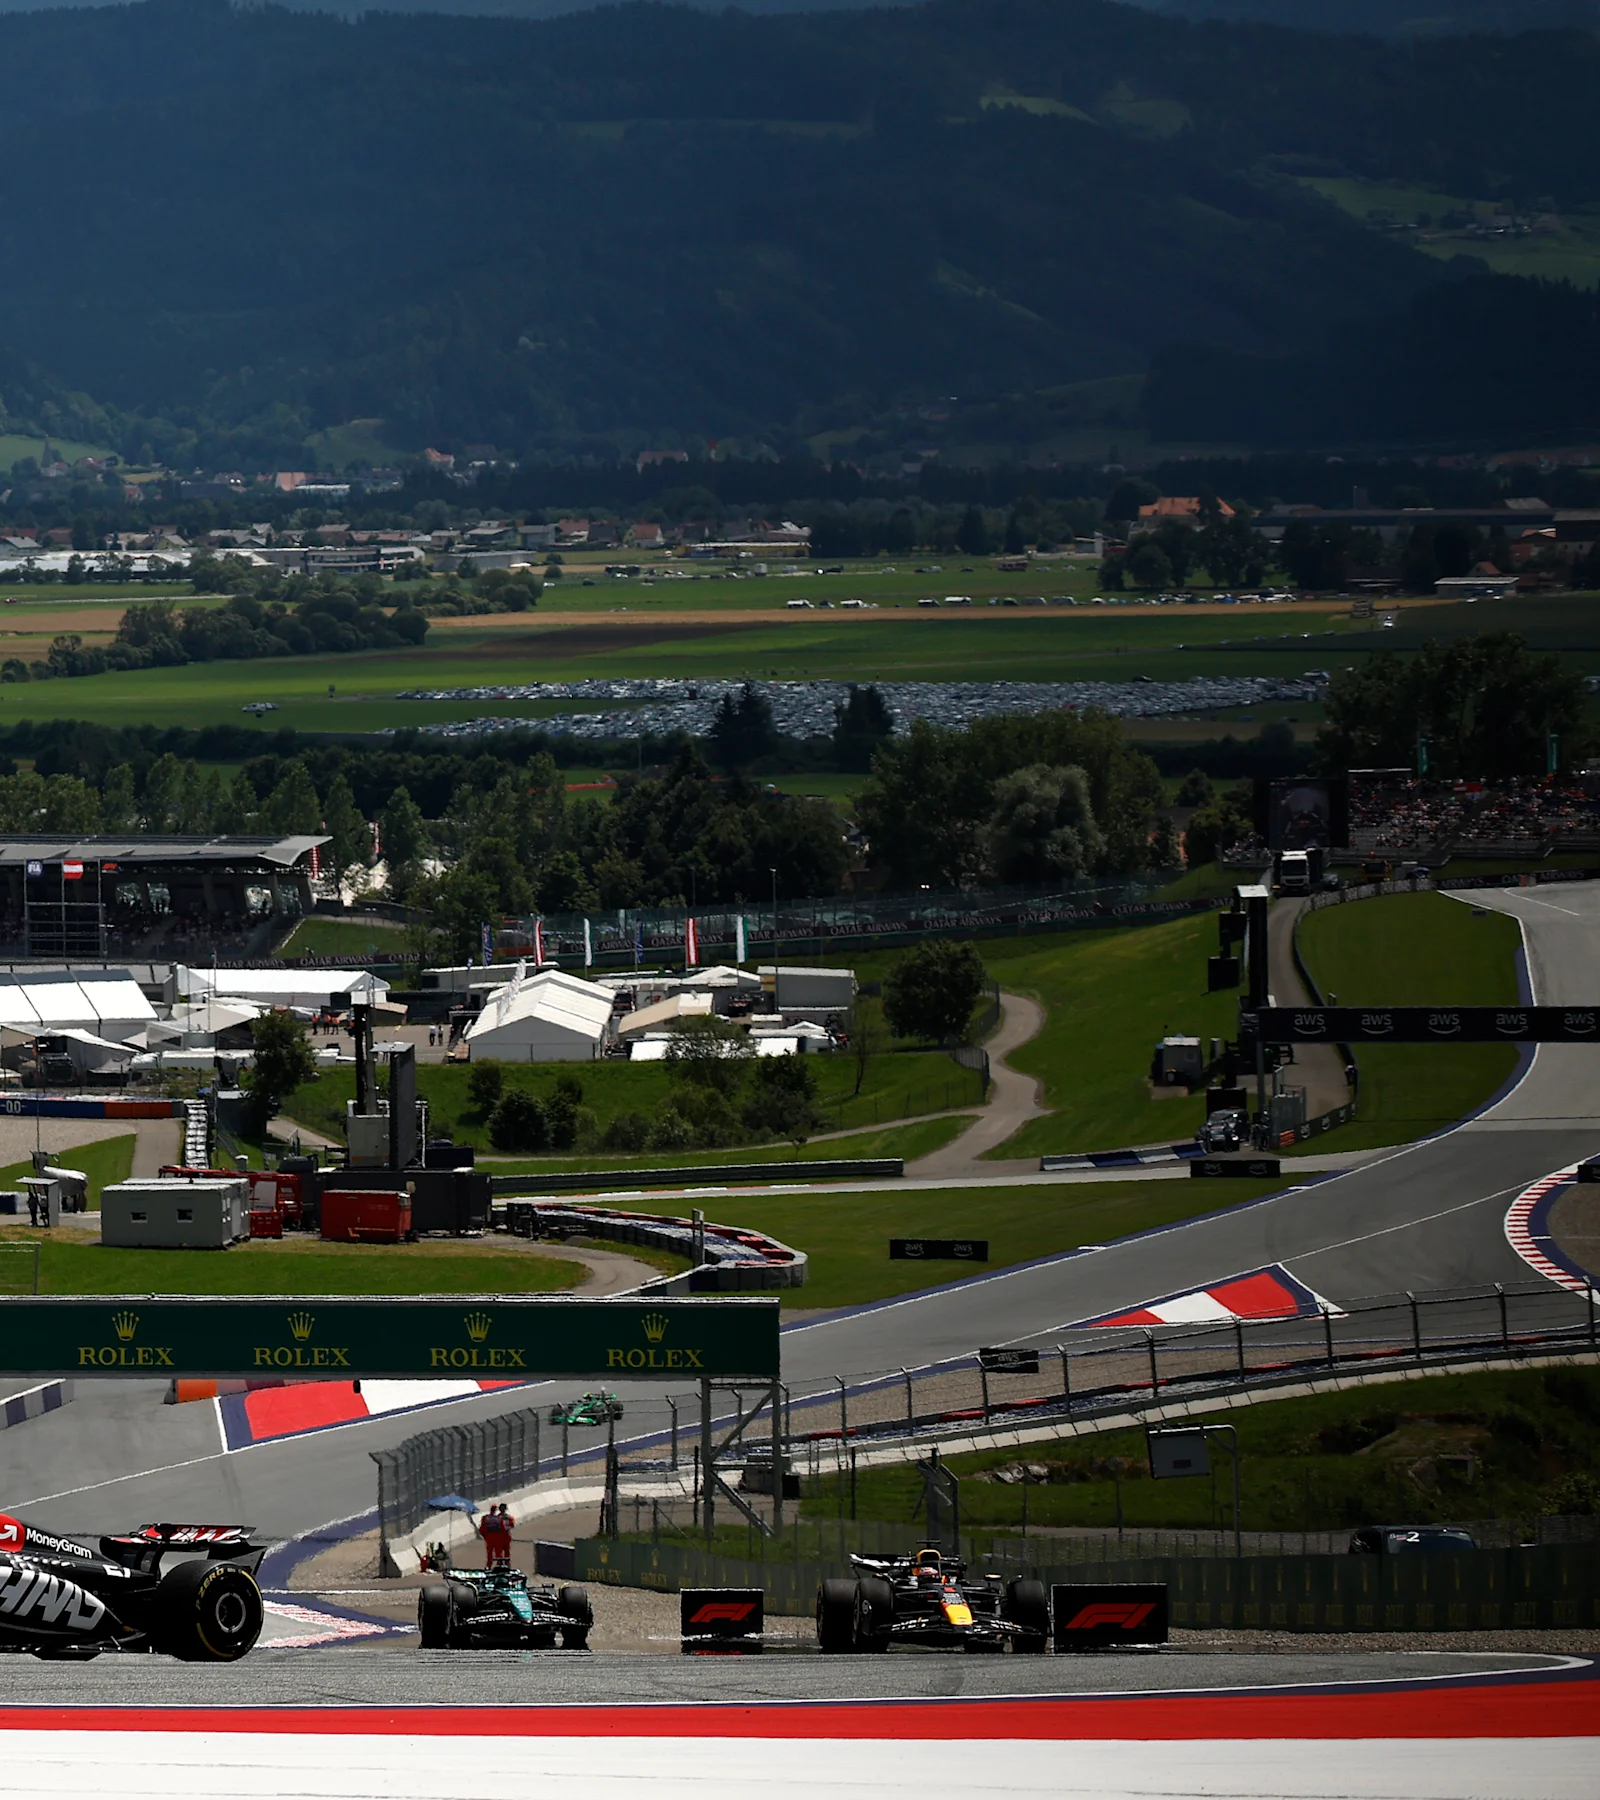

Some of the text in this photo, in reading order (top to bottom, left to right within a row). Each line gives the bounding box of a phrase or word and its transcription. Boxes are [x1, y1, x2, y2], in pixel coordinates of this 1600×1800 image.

[27, 864, 41, 873] FIA
[1053, 909, 1097, 920] AIRWAYS
[1111, 901, 1192, 918] QATAR AIRWAYS
[830, 922, 908, 936] QATAR AIRWAYS
[923, 916, 1002, 930] QATAR AIRWAYS
[748, 928, 815, 940] ATAR AIRWAYS
[301, 955, 374, 967] QATAR AIRWAYS
[1294, 1013, 1325, 1025] aws
[1361, 1013, 1392, 1025] aws
[1429, 1013, 1460, 1025] aws
[1496, 1013, 1528, 1025] aws
[1564, 1012, 1596, 1025] aws
[905, 1243, 923, 1251] aws
[953, 1244, 972, 1252] aws
[78, 1346, 174, 1367] ROLEX
[253, 1346, 349, 1367] ROLEX
[430, 1347, 527, 1368] ROLEX
[606, 1348, 703, 1368] ROLEX
[25, 1527, 93, 1560] MoneyGram
[688, 1603, 757, 1623] F1
[1064, 1603, 1158, 1629] F1
